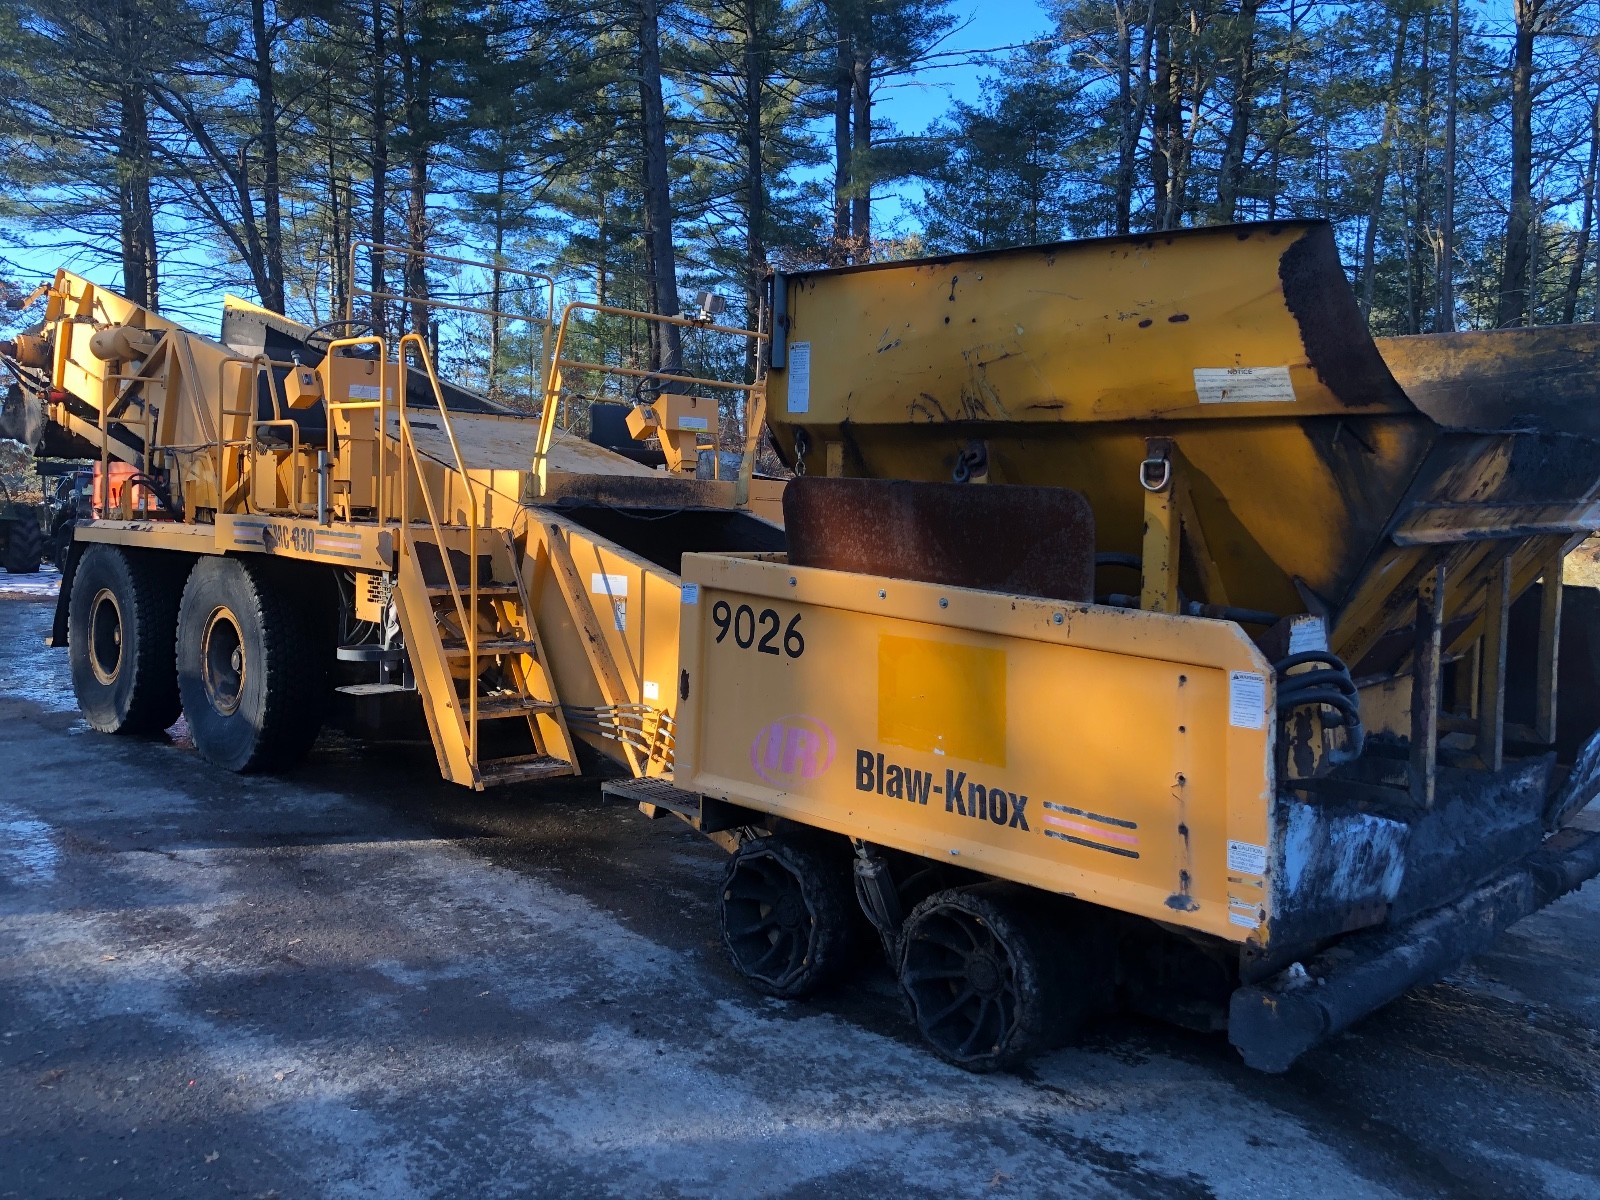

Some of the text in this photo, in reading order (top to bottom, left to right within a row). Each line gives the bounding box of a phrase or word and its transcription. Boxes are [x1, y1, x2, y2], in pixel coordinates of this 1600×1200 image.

[712, 600, 805, 659] 9026
[855, 748, 1031, 832] Blaw-Knox
[1237, 844, 1264, 855] CAUTION
